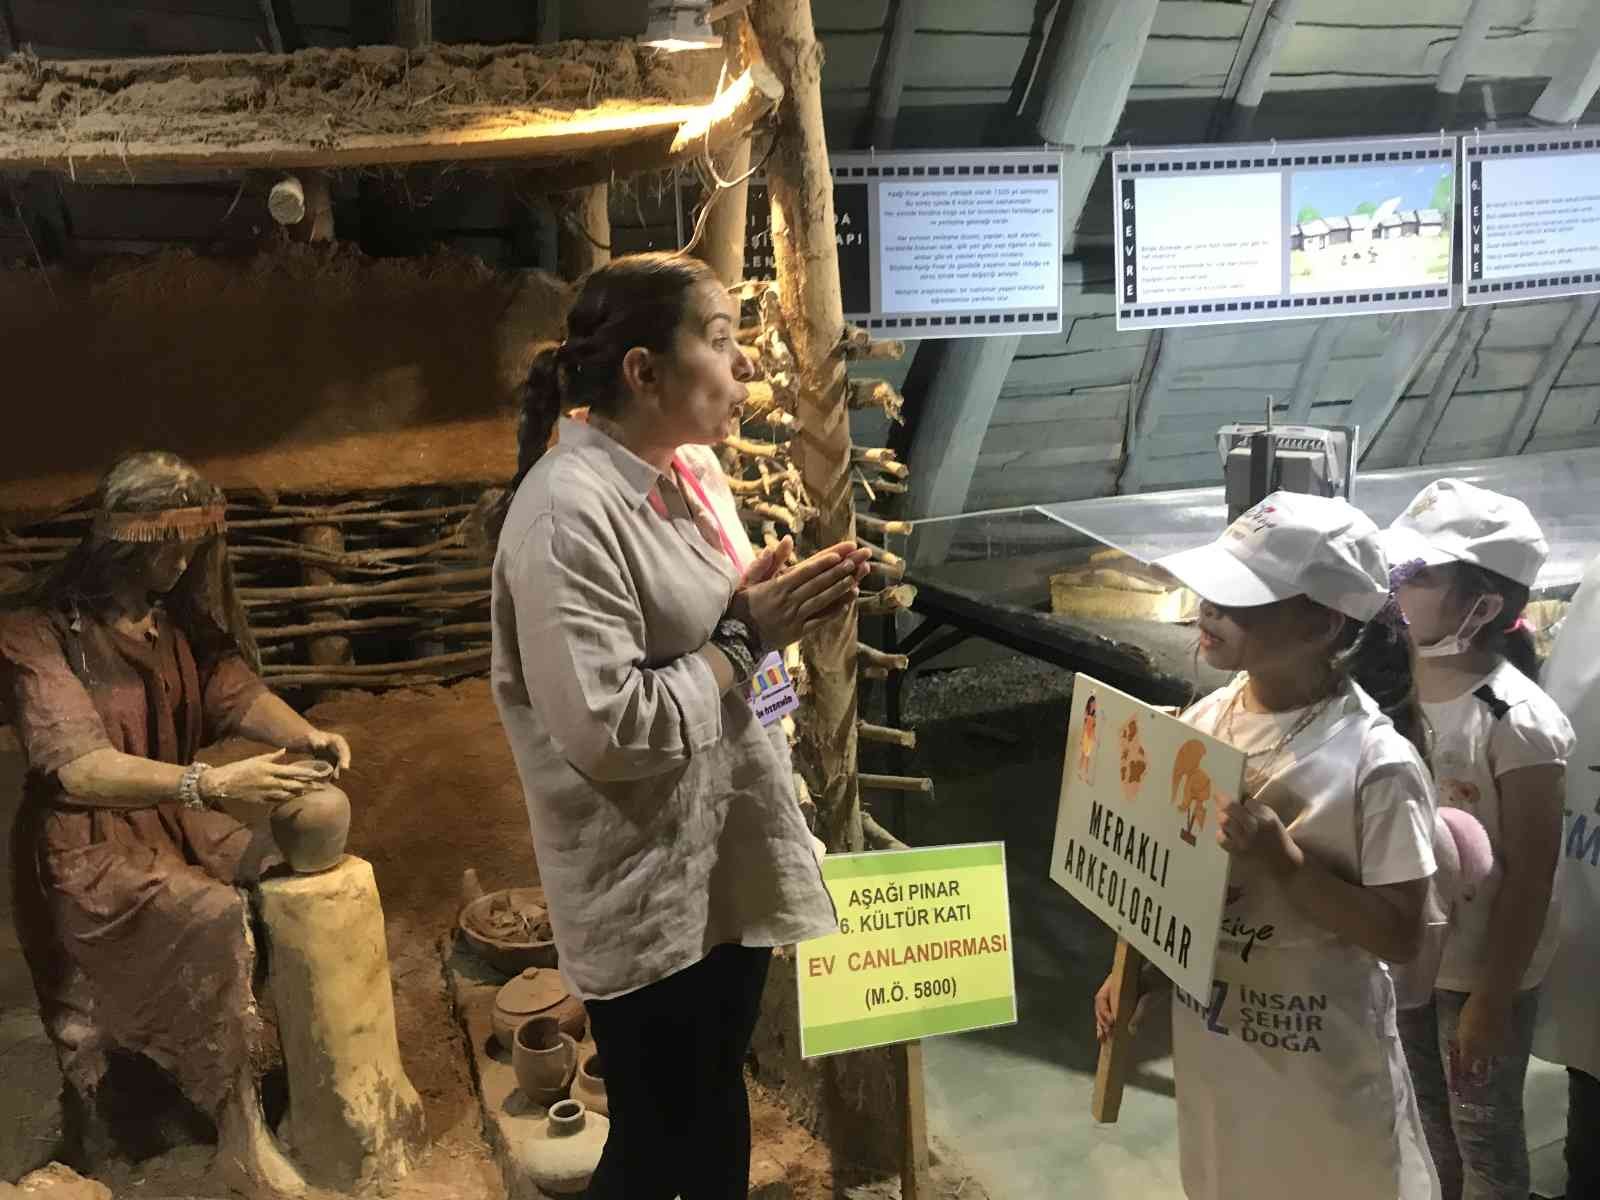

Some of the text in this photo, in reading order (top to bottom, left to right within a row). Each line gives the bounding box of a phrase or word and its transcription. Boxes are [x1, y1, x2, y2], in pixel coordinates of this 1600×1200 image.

[1089, 800, 1169, 888] MERAKLI
[849, 880, 960, 909] AŞAĞI PINAR
[1064, 839, 1192, 969] ARKEOLOGLAR
[840, 903, 971, 935] 6. KÜLTÜR KATI
[808, 934, 1007, 977] EV CANLANDIRMASI
[865, 977, 957, 1011] (M.Ö. 5800)
